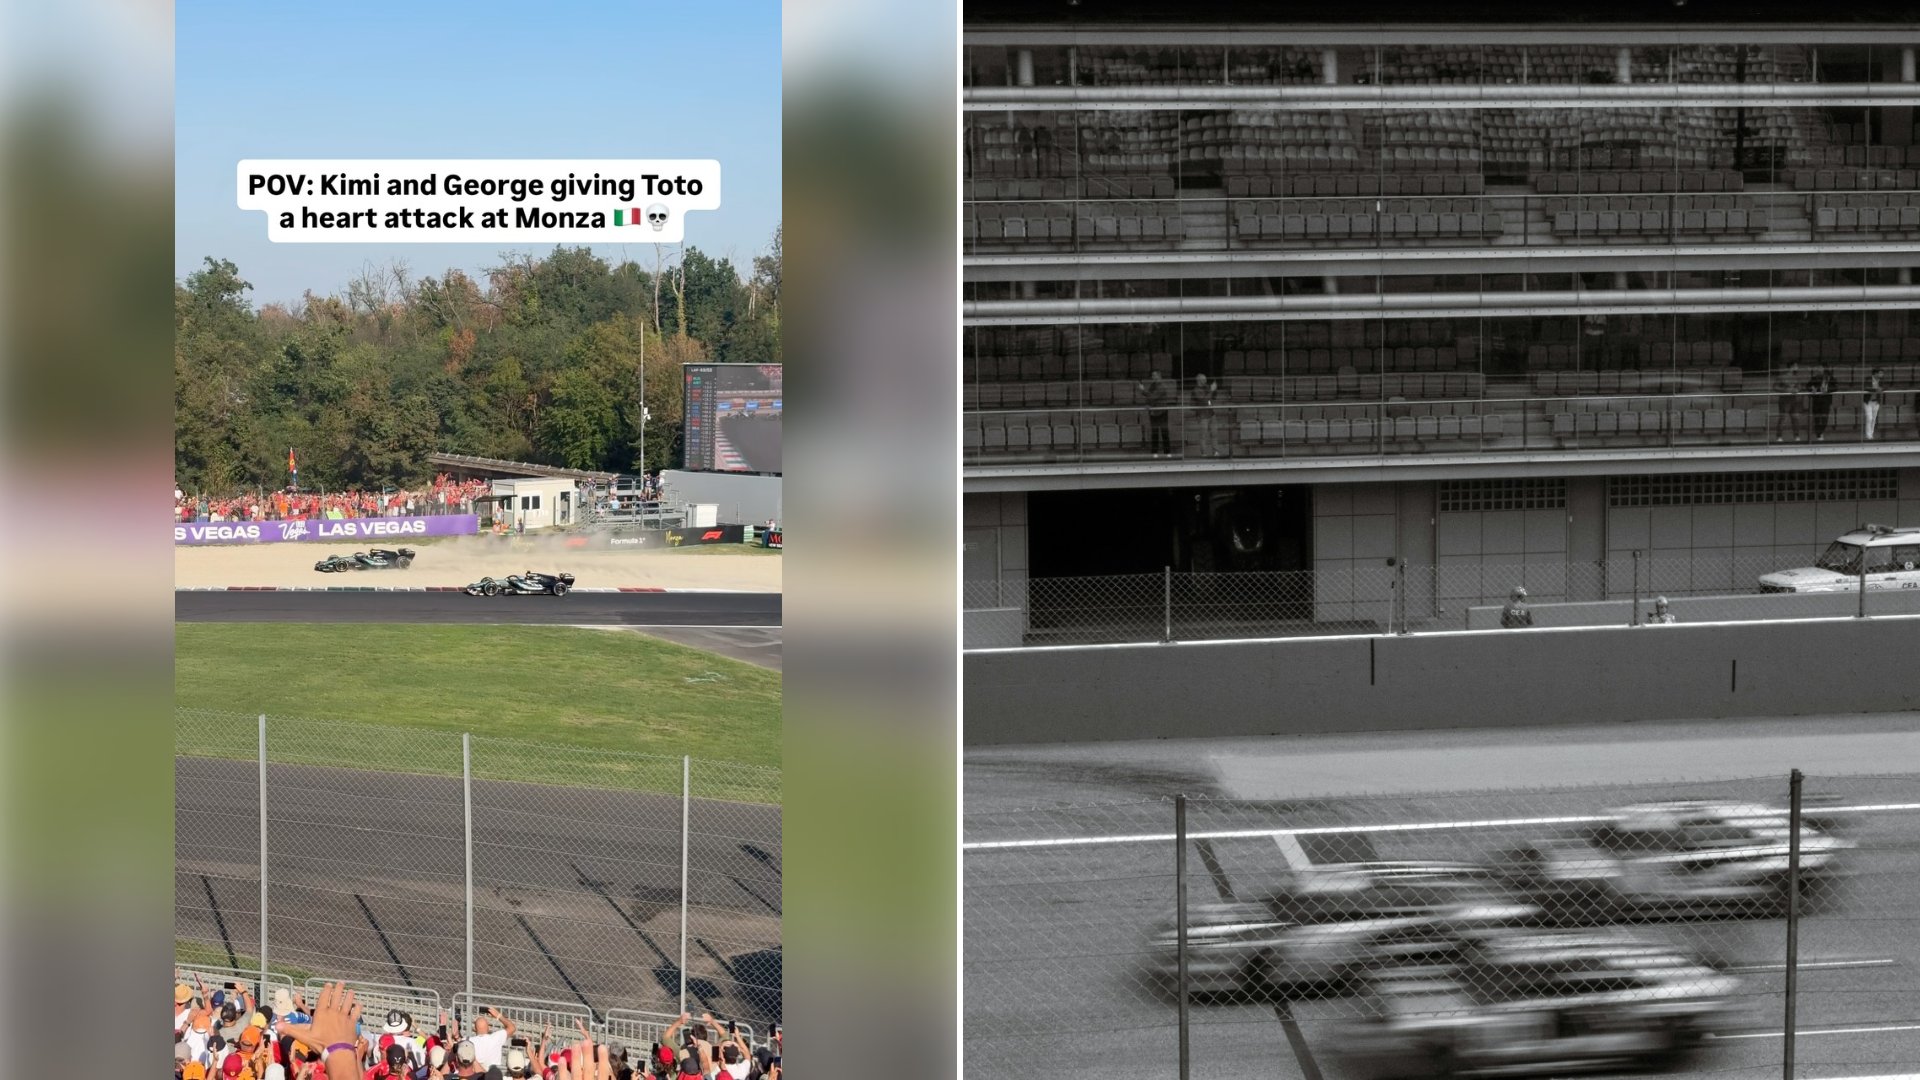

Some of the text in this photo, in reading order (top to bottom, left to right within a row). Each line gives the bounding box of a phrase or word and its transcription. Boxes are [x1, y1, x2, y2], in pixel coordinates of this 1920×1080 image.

[190, 525, 260, 540] VEGAS
[318, 522, 357, 537] LAS
[358, 519, 426, 535] VEGAS
[610, 537, 639, 545] Formula
